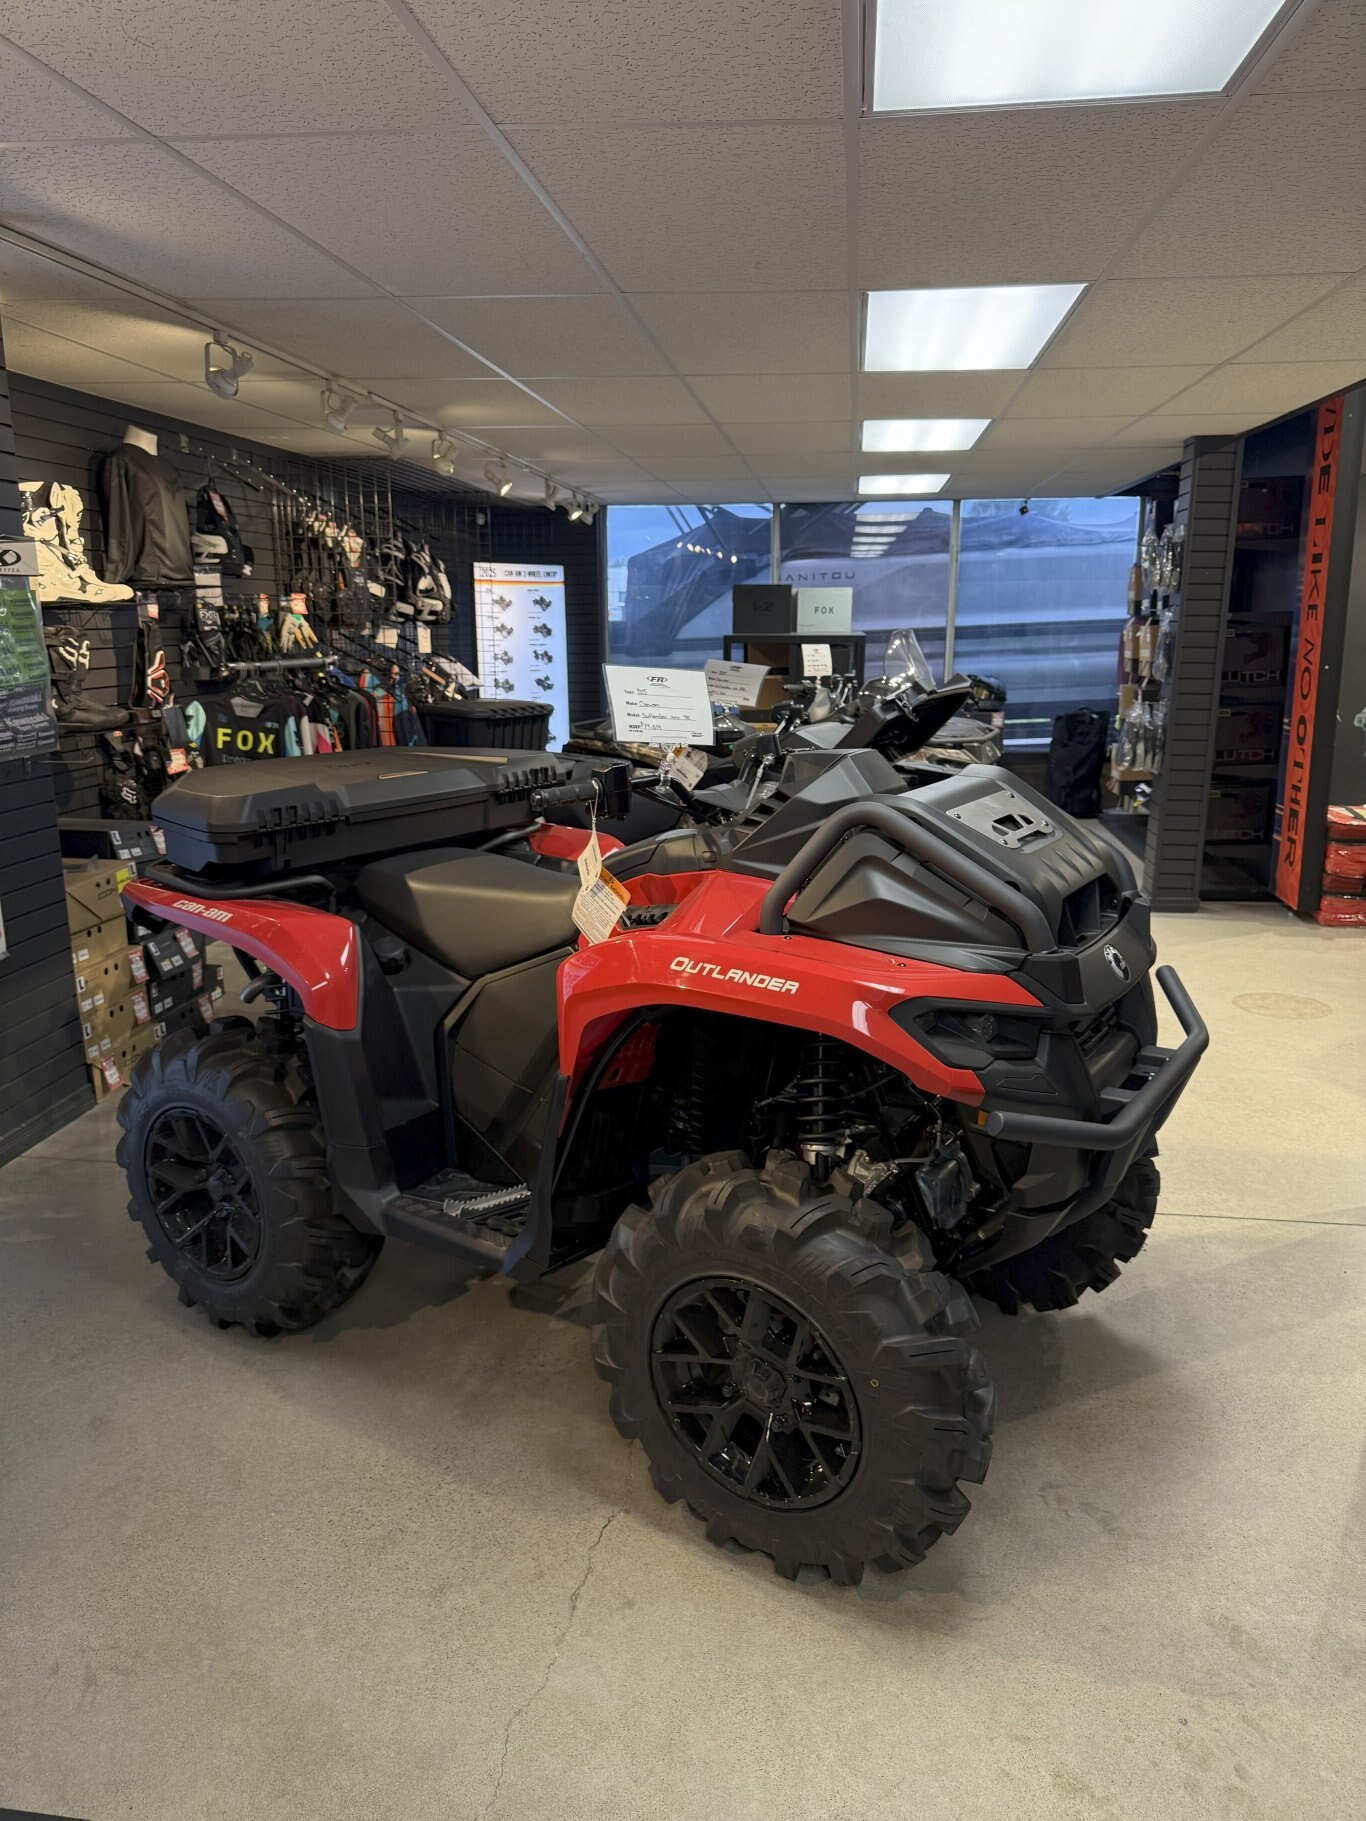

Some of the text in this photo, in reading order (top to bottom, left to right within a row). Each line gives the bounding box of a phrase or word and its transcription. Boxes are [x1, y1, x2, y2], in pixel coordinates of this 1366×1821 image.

[1306, 516, 1326, 622] LIKE
[814, 606, 834, 615] FOX
[1301, 638, 1315, 701] NO
[216, 727, 275, 754] FOX
[1284, 714, 1307, 868] OTHER
[172, 899, 234, 923] can-am
[669, 956, 800, 995] OUTLANDER
